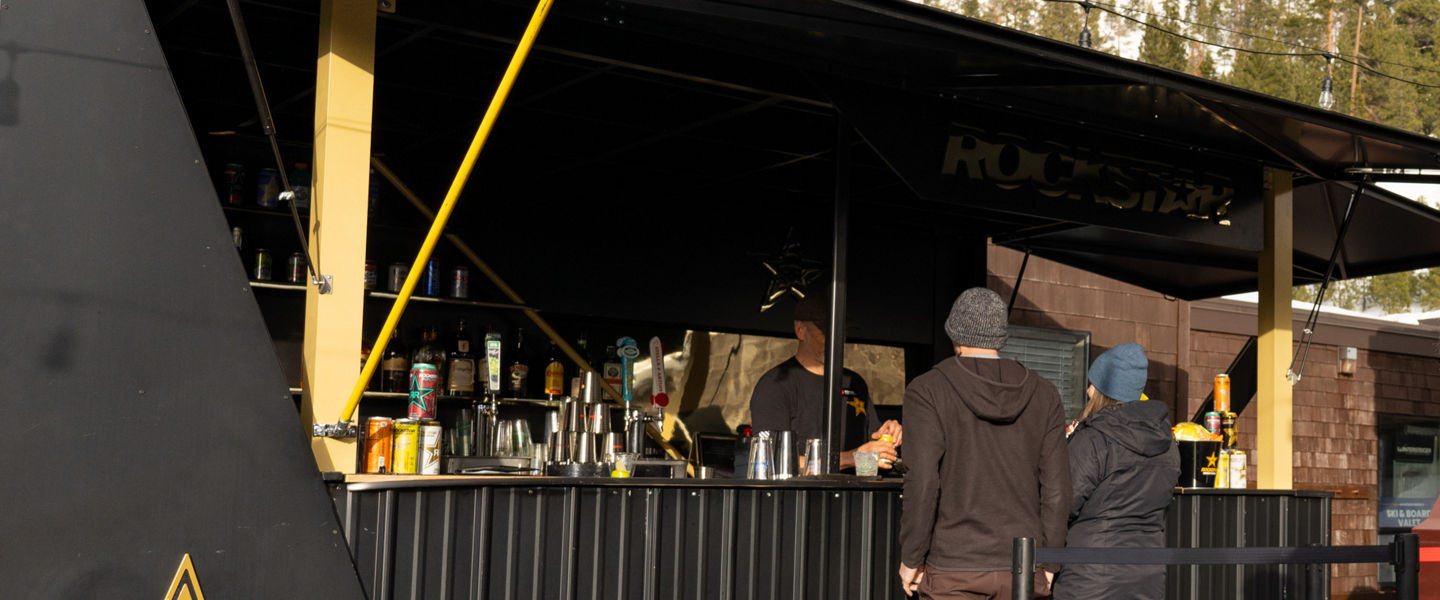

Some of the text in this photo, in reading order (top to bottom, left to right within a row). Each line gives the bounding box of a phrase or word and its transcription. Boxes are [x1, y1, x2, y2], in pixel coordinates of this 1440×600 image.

[941, 122, 1235, 226] ROCKSTAR
[1386, 509, 1398, 518] SKI
[1399, 509, 1405, 518] &
[1398, 518, 1421, 527] VALET
